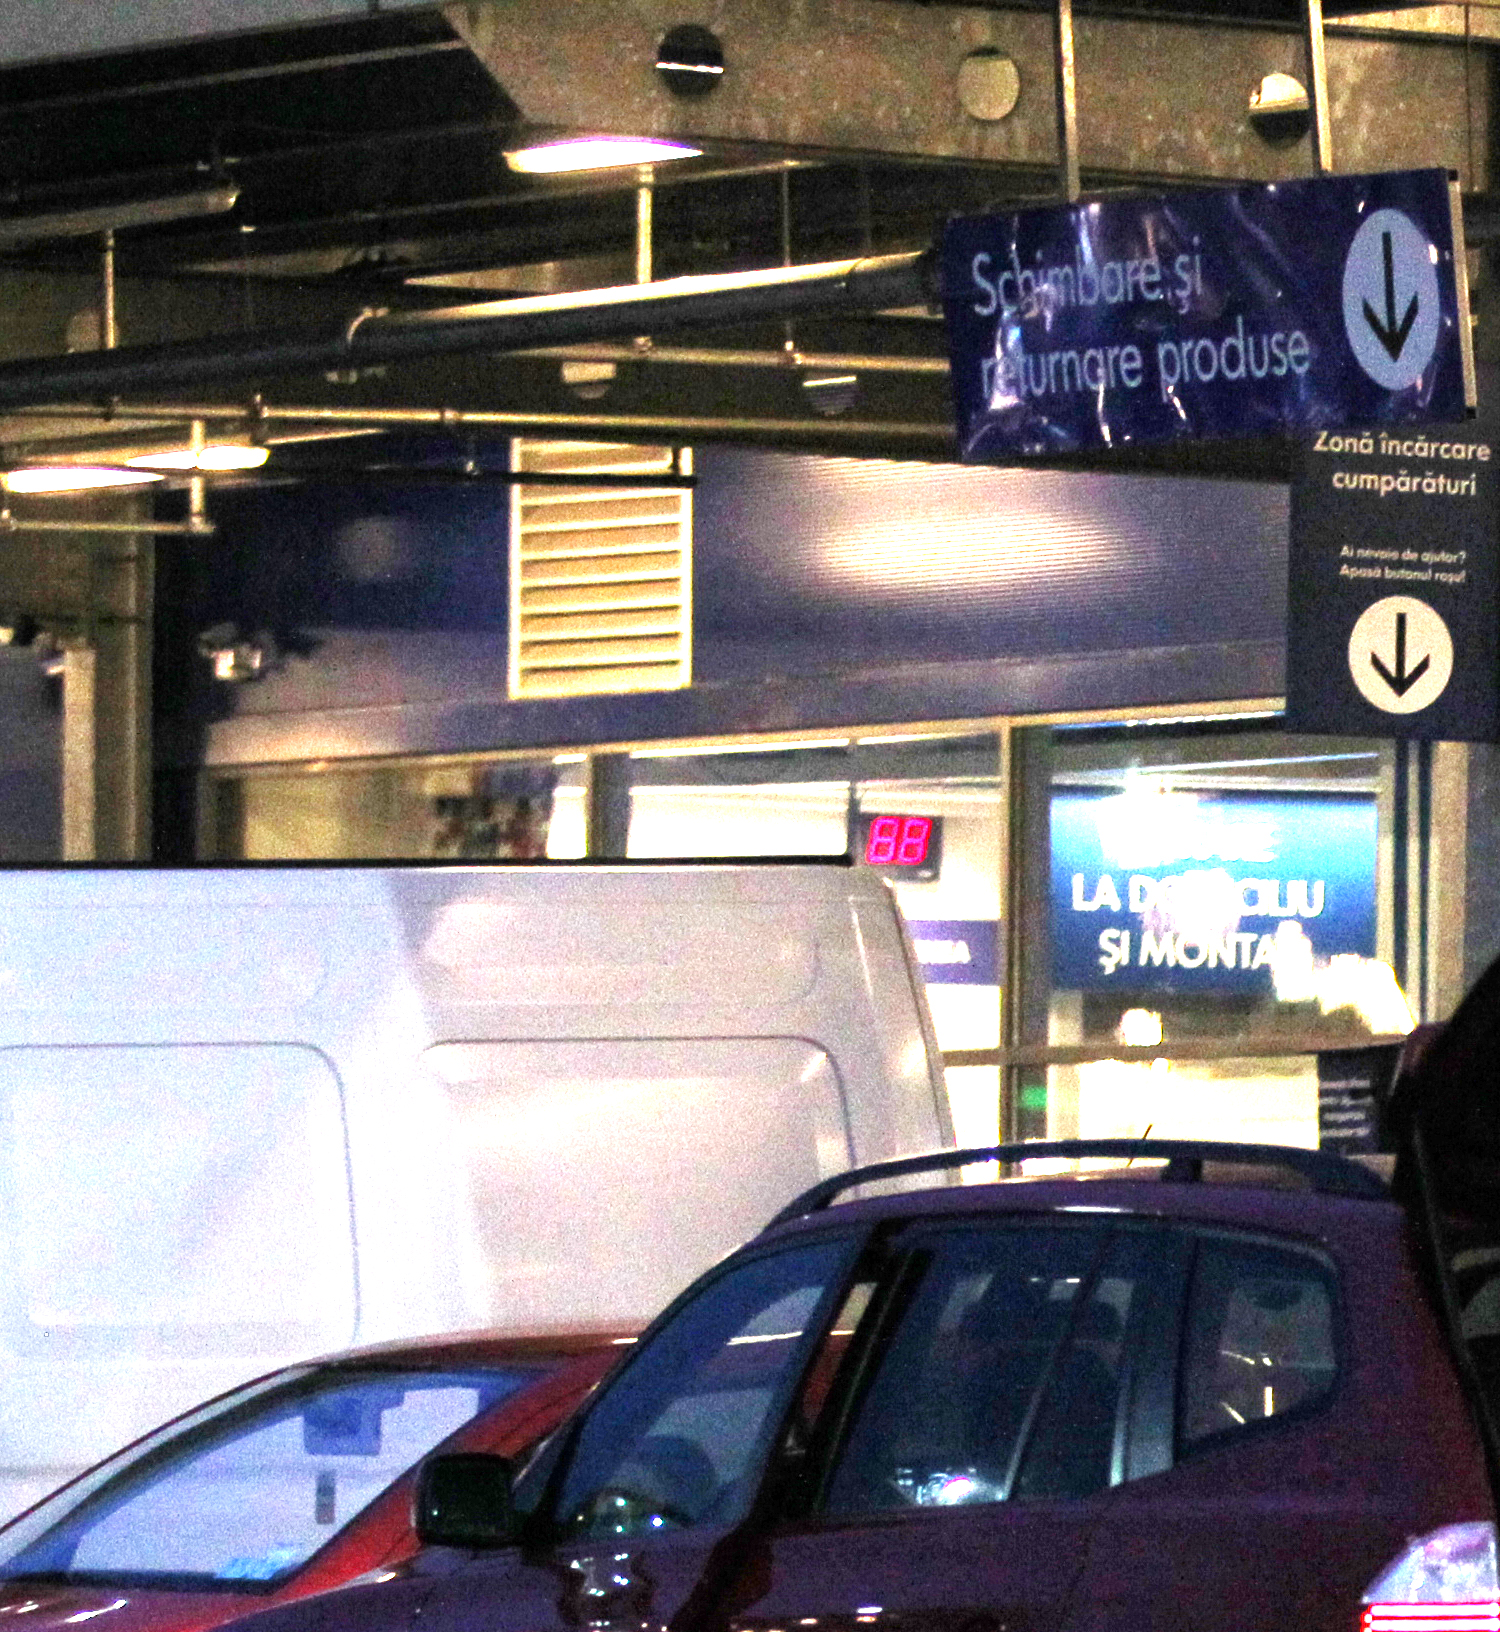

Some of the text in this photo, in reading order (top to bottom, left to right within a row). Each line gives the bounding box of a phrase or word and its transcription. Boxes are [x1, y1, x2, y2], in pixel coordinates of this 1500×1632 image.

[972, 244, 1162, 317] Schimbare
[982, 315, 1310, 402] returnare produse
[1313, 430, 1492, 461] Zonă încărcare
[1332, 469, 1477, 497] cumpărături
[1072, 873, 1121, 912] LA
[1139, 931, 1282, 969] MONTA
